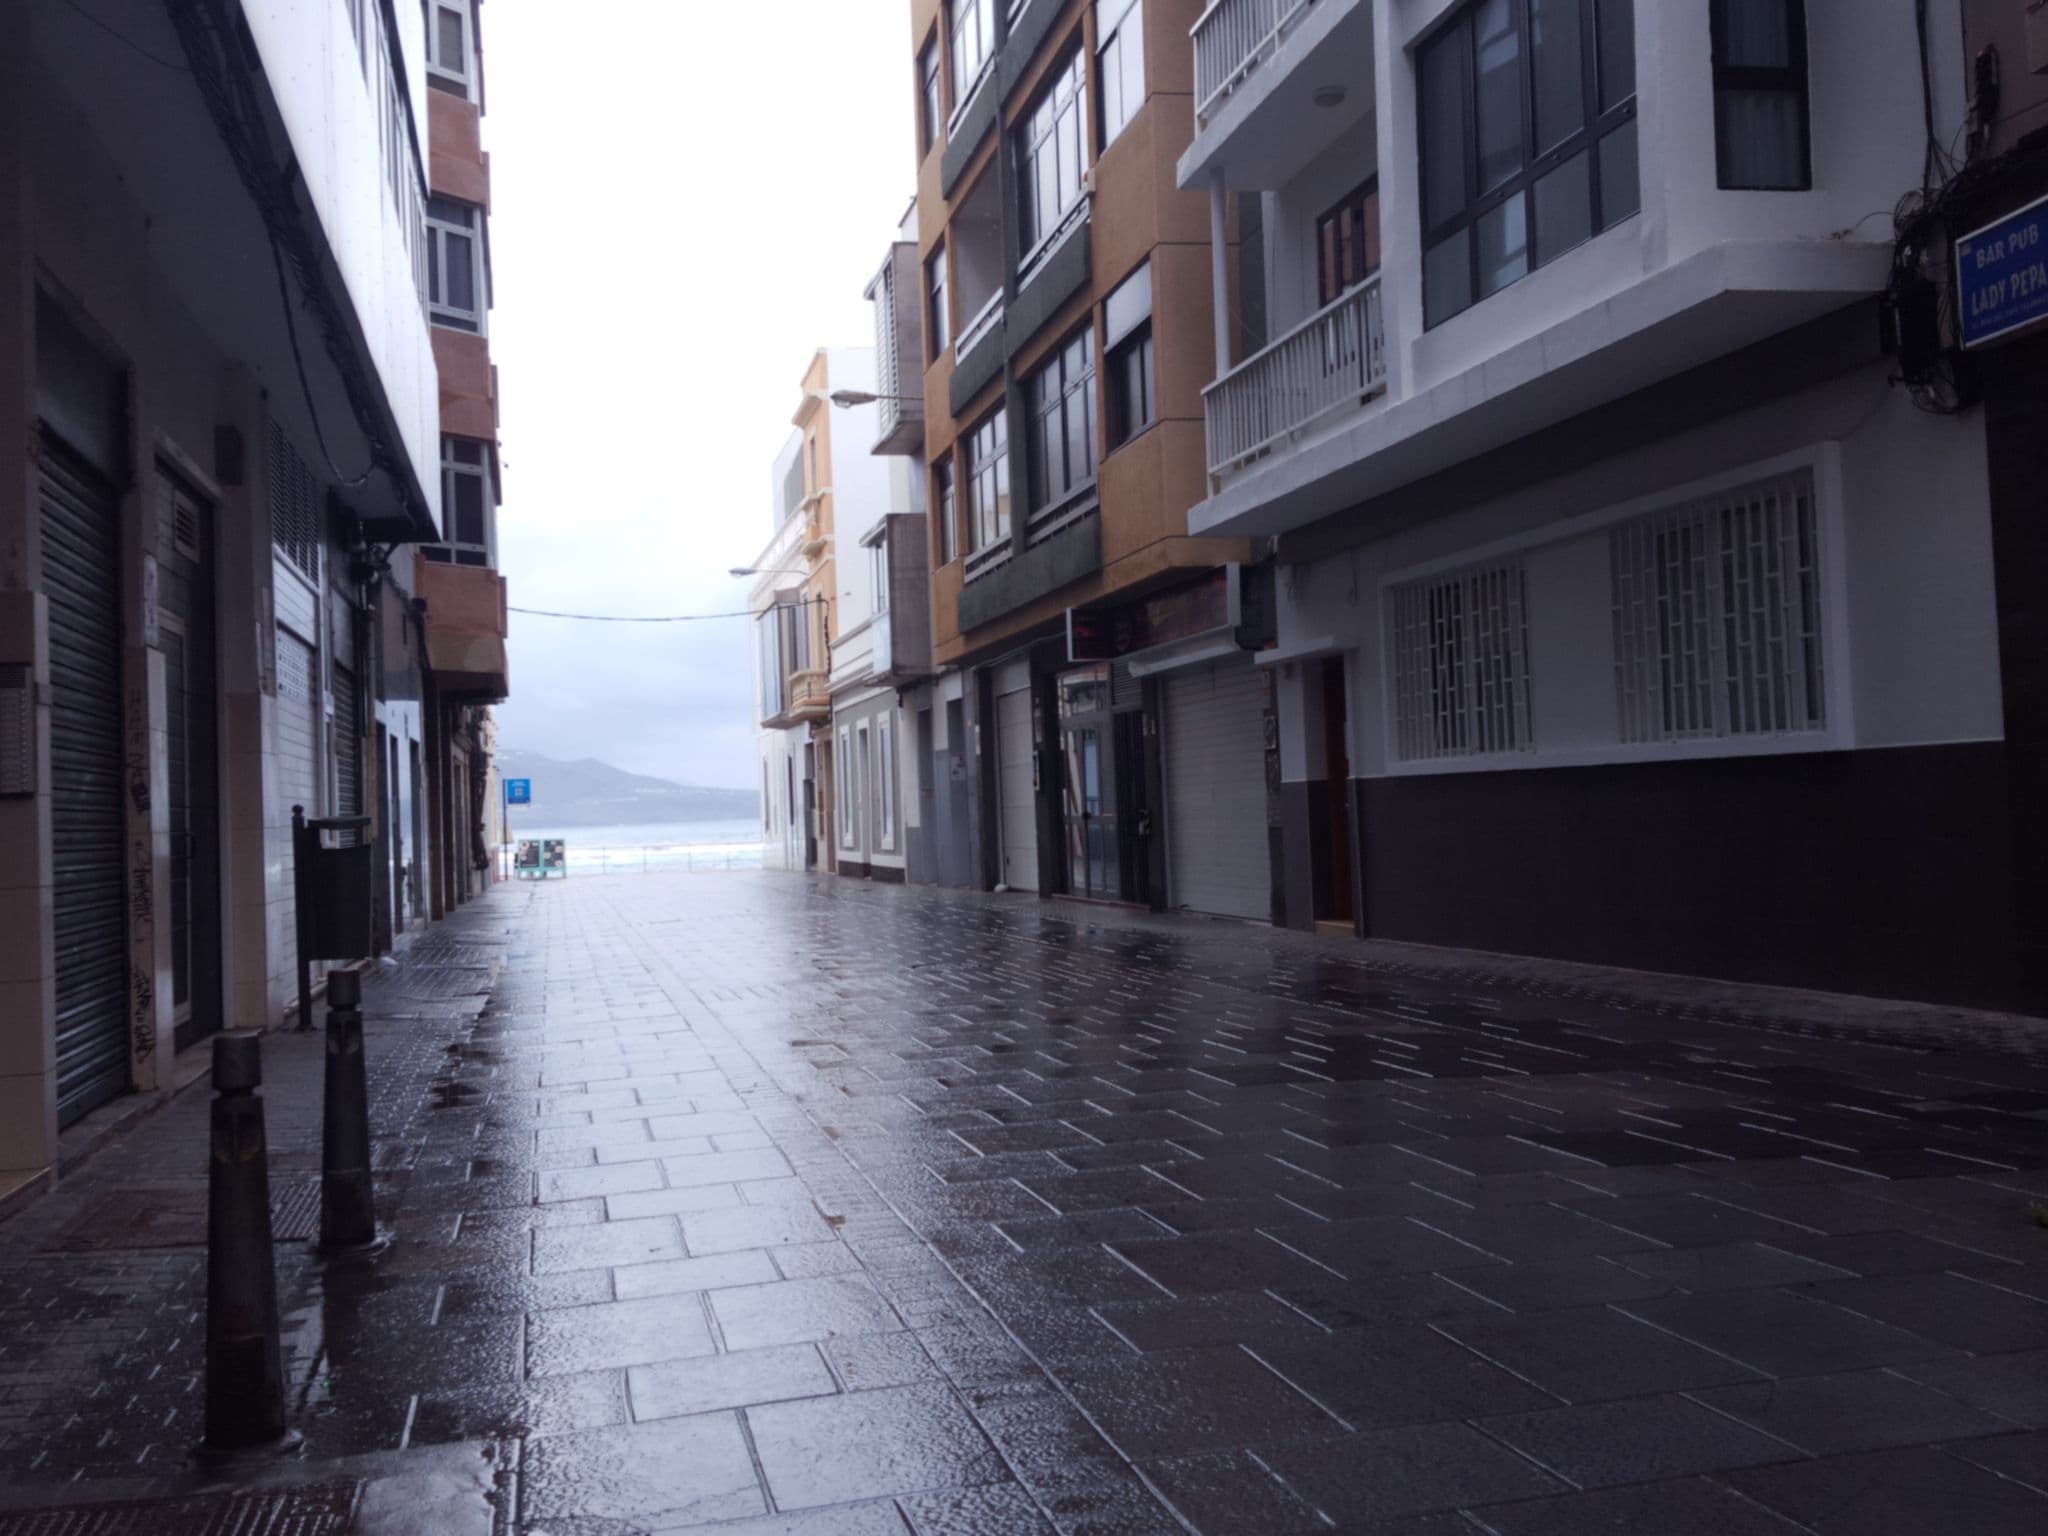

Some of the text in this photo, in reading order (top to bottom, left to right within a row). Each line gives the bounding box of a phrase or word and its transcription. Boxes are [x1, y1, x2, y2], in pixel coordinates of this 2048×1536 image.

[1976, 224, 2039, 269] BAR PUB
[1972, 279, 2006, 316] LADY
[2010, 262, 2048, 299] PEPA
